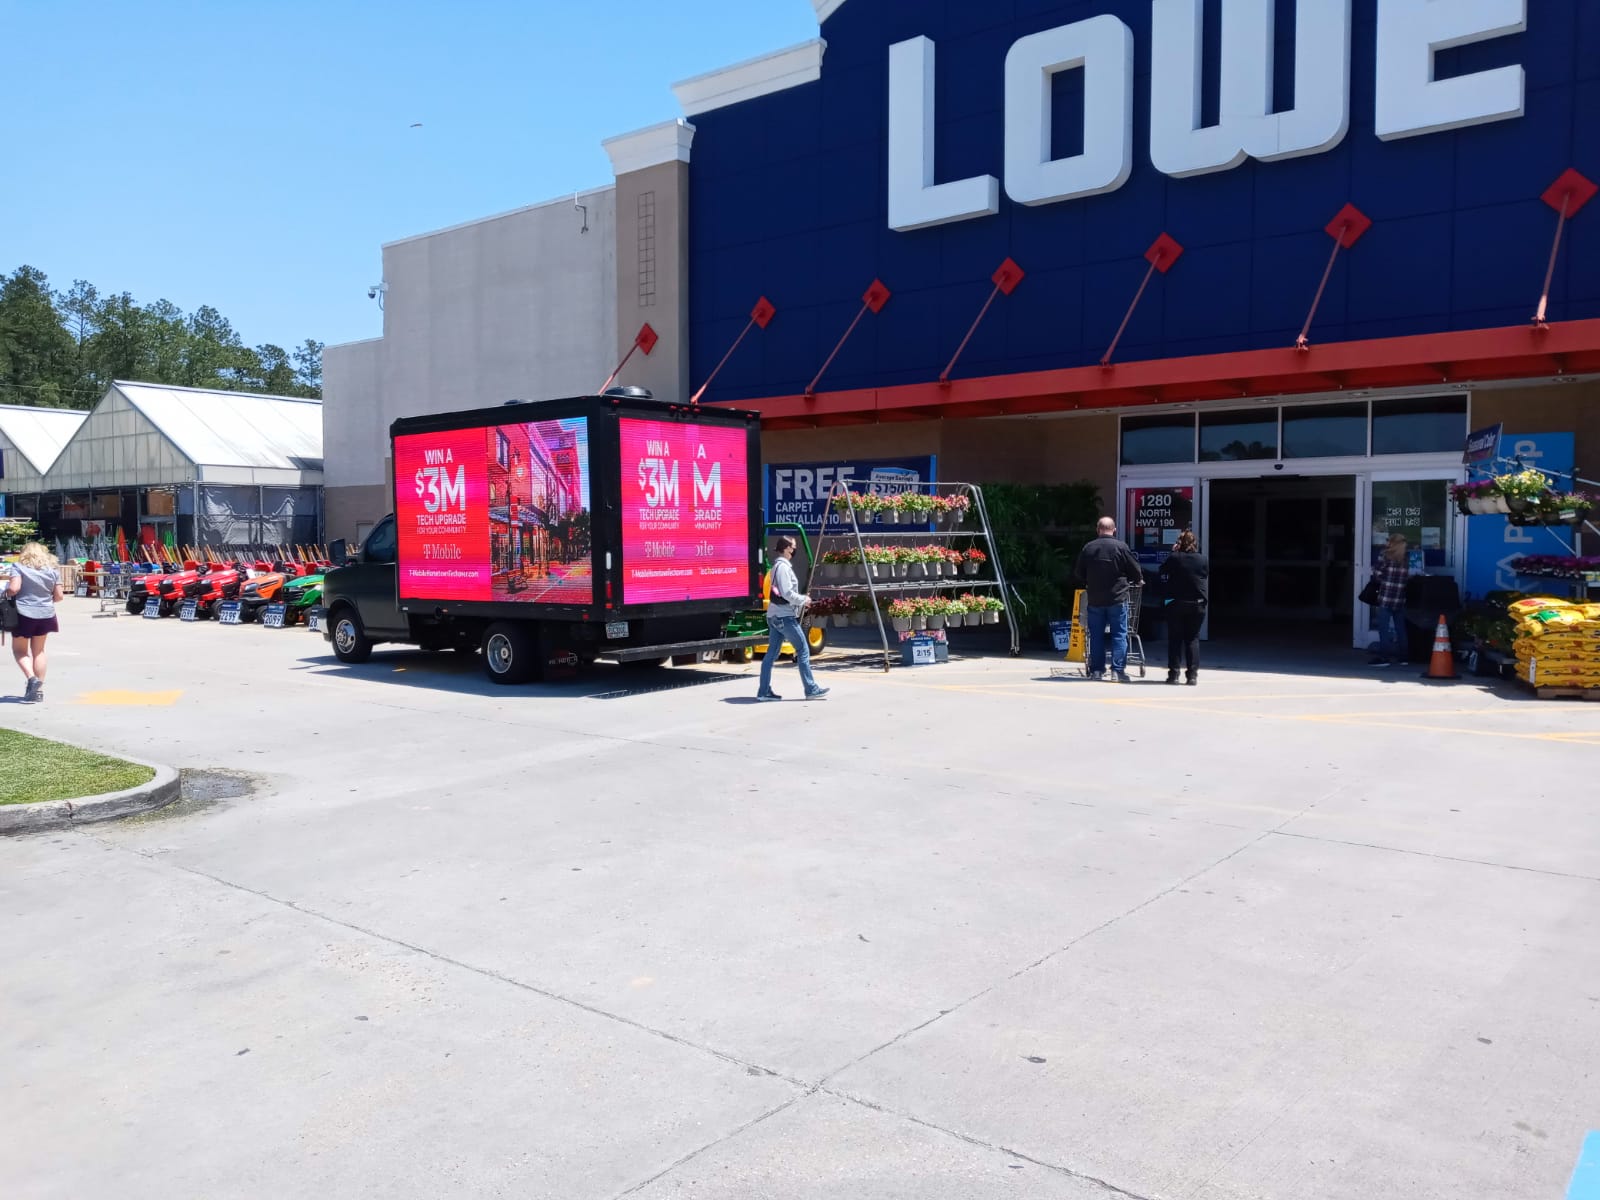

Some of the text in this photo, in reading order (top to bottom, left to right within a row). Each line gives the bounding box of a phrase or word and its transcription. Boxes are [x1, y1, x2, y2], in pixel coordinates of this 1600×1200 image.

[888, 0, 1527, 232] LOWE
[646, 439, 670, 457] WIN A
[424, 448, 454, 465] WIN A
[415, 464, 466, 513] $3M
[638, 457, 680, 508] $3M
[775, 466, 856, 500] FREE
[775, 501, 814, 513] CARPET
[1140, 494, 1172, 507] 1280
[416, 513, 467, 526] TECH UPGRADE
[639, 508, 680, 521] TECH UPGRADE
[775, 513, 840, 525] INSTALLATIO
[1139, 508, 1171, 518] NORTH
[647, 521, 657, 529] YOUR
[656, 521, 680, 530] COMMUNITY
[1136, 518, 1175, 527] HWY 190
[416, 525, 467, 535] FOR YOUR COMMUNITY
[310, 616, 318, 627] 28
